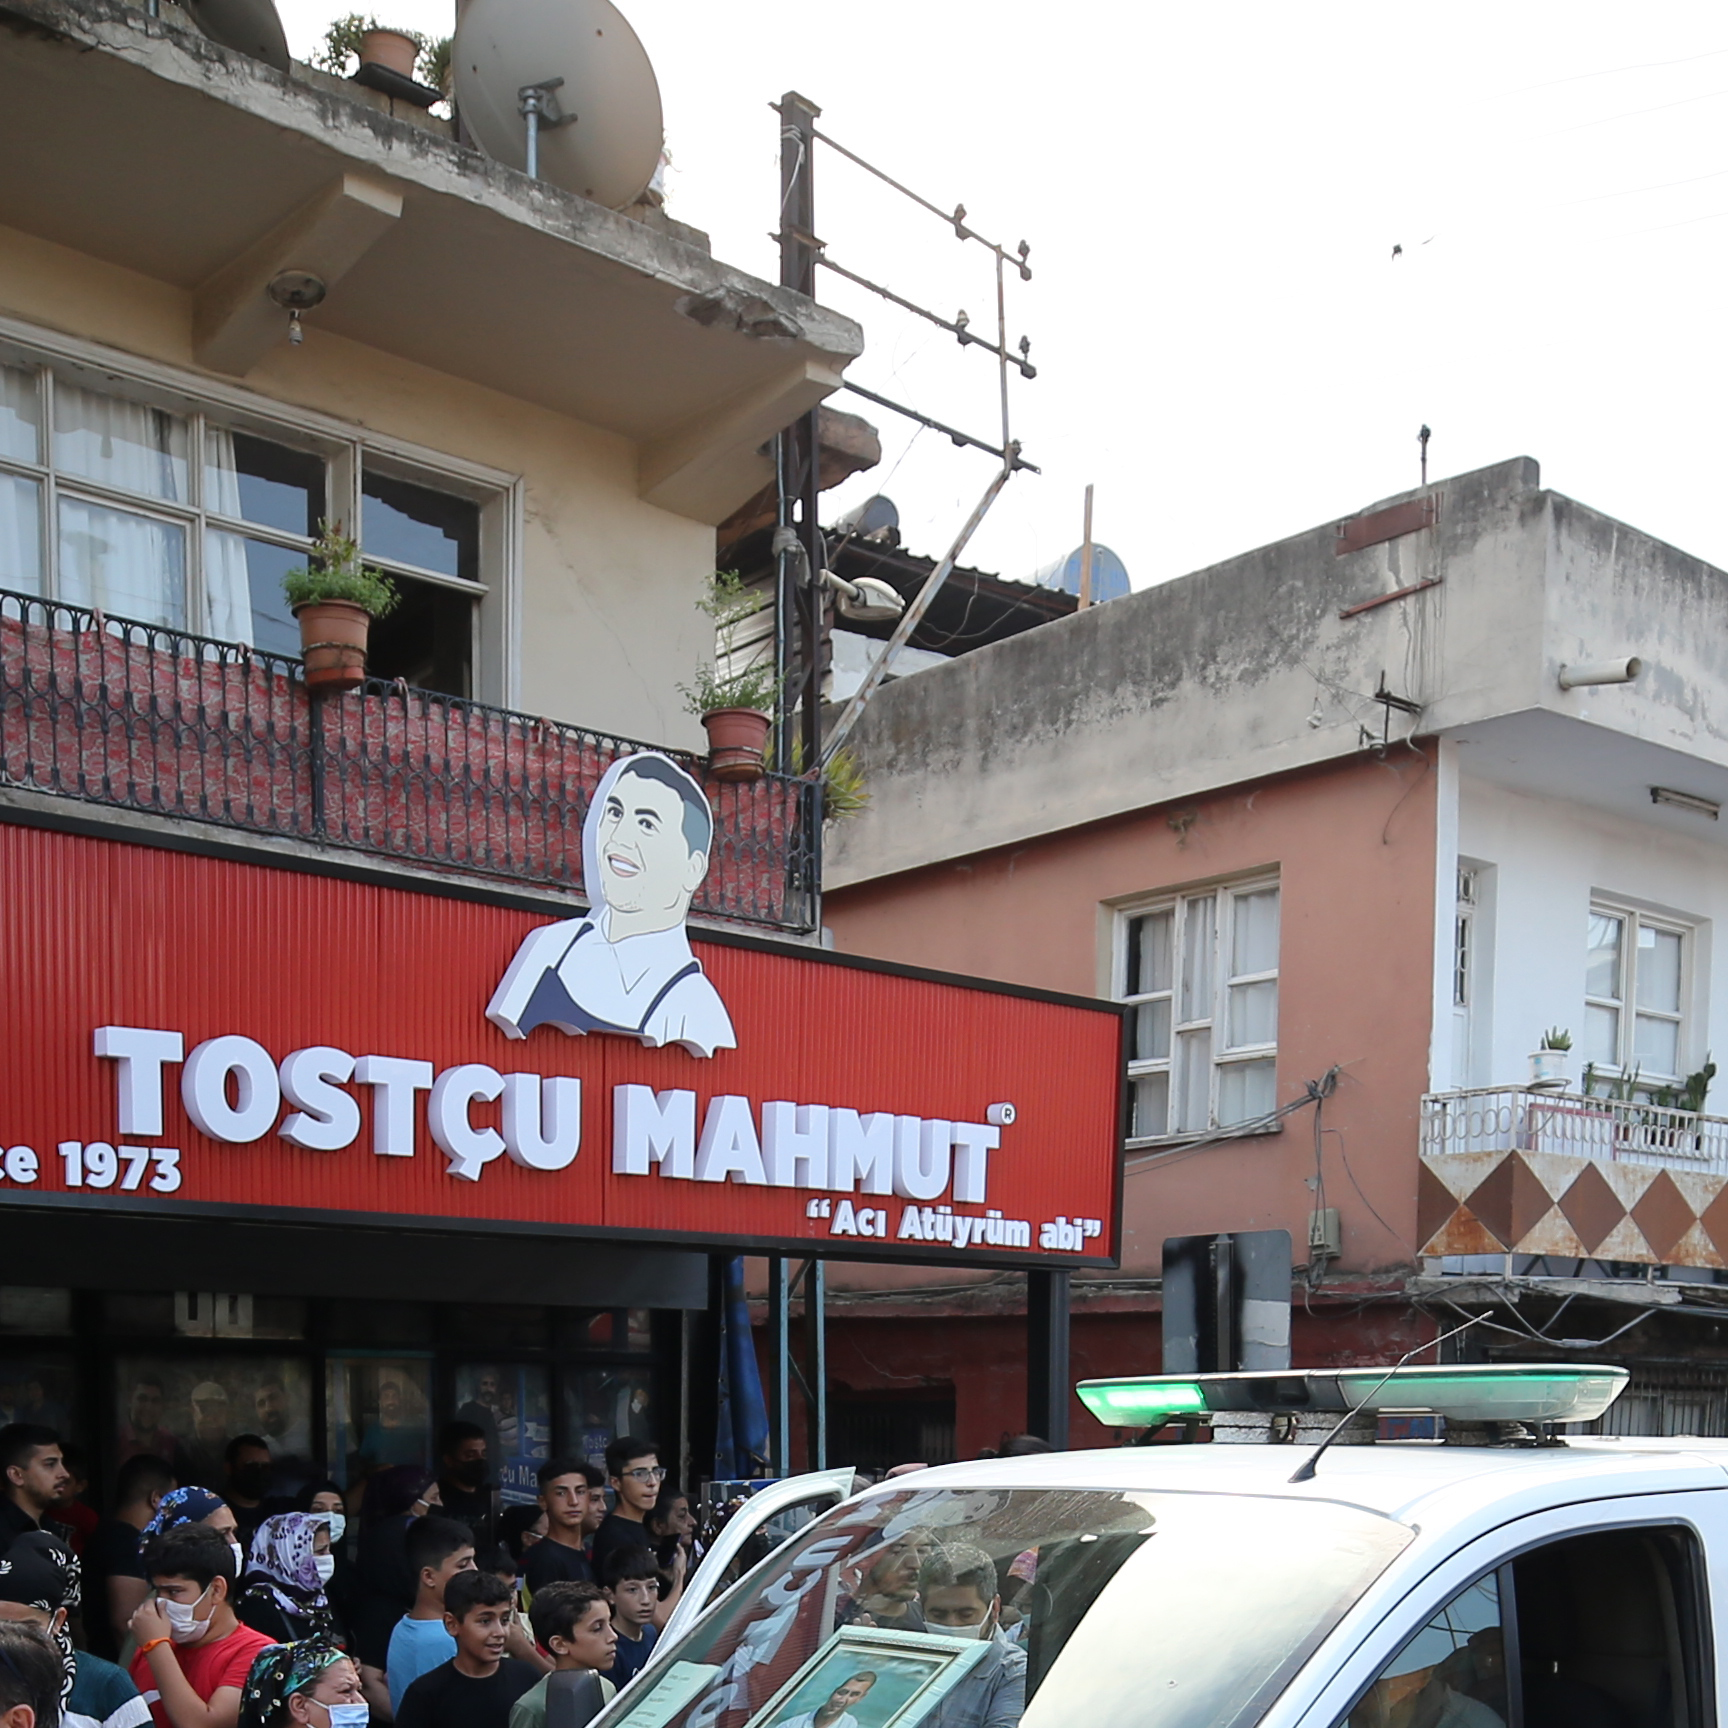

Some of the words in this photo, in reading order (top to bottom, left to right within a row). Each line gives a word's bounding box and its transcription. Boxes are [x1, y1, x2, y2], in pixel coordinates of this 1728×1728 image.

[94, 1025, 582, 1182] TOSTÇU
[612, 1083, 1000, 1204] MAHMUT
[57, 1140, 182, 1193] 1973
[899, 1205, 1031, 1249] Atüyrüm
